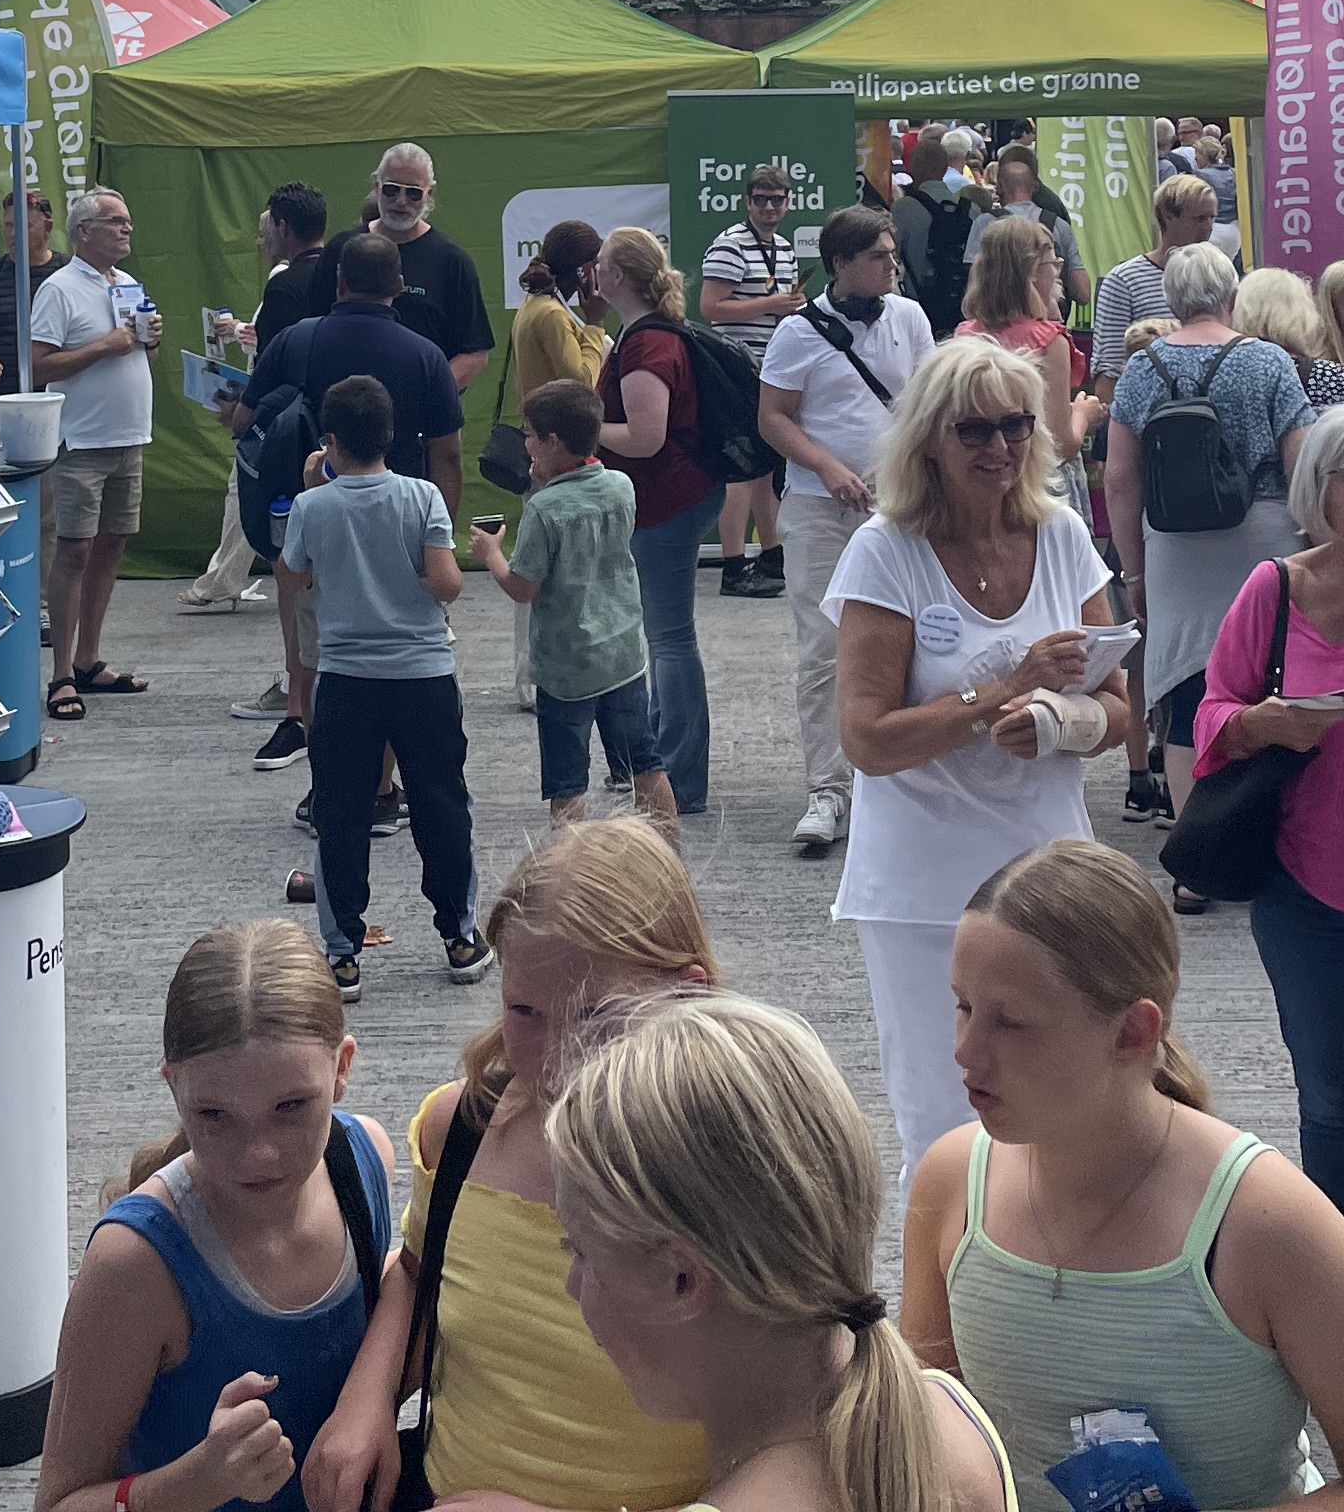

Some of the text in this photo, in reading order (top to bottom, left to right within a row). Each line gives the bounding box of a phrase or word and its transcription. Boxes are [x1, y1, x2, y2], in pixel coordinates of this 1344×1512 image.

[829, 71, 1141, 102] miljøpartiet de grønne
[699, 155, 816, 184] For lle,
[698, 185, 825, 212] for tid
